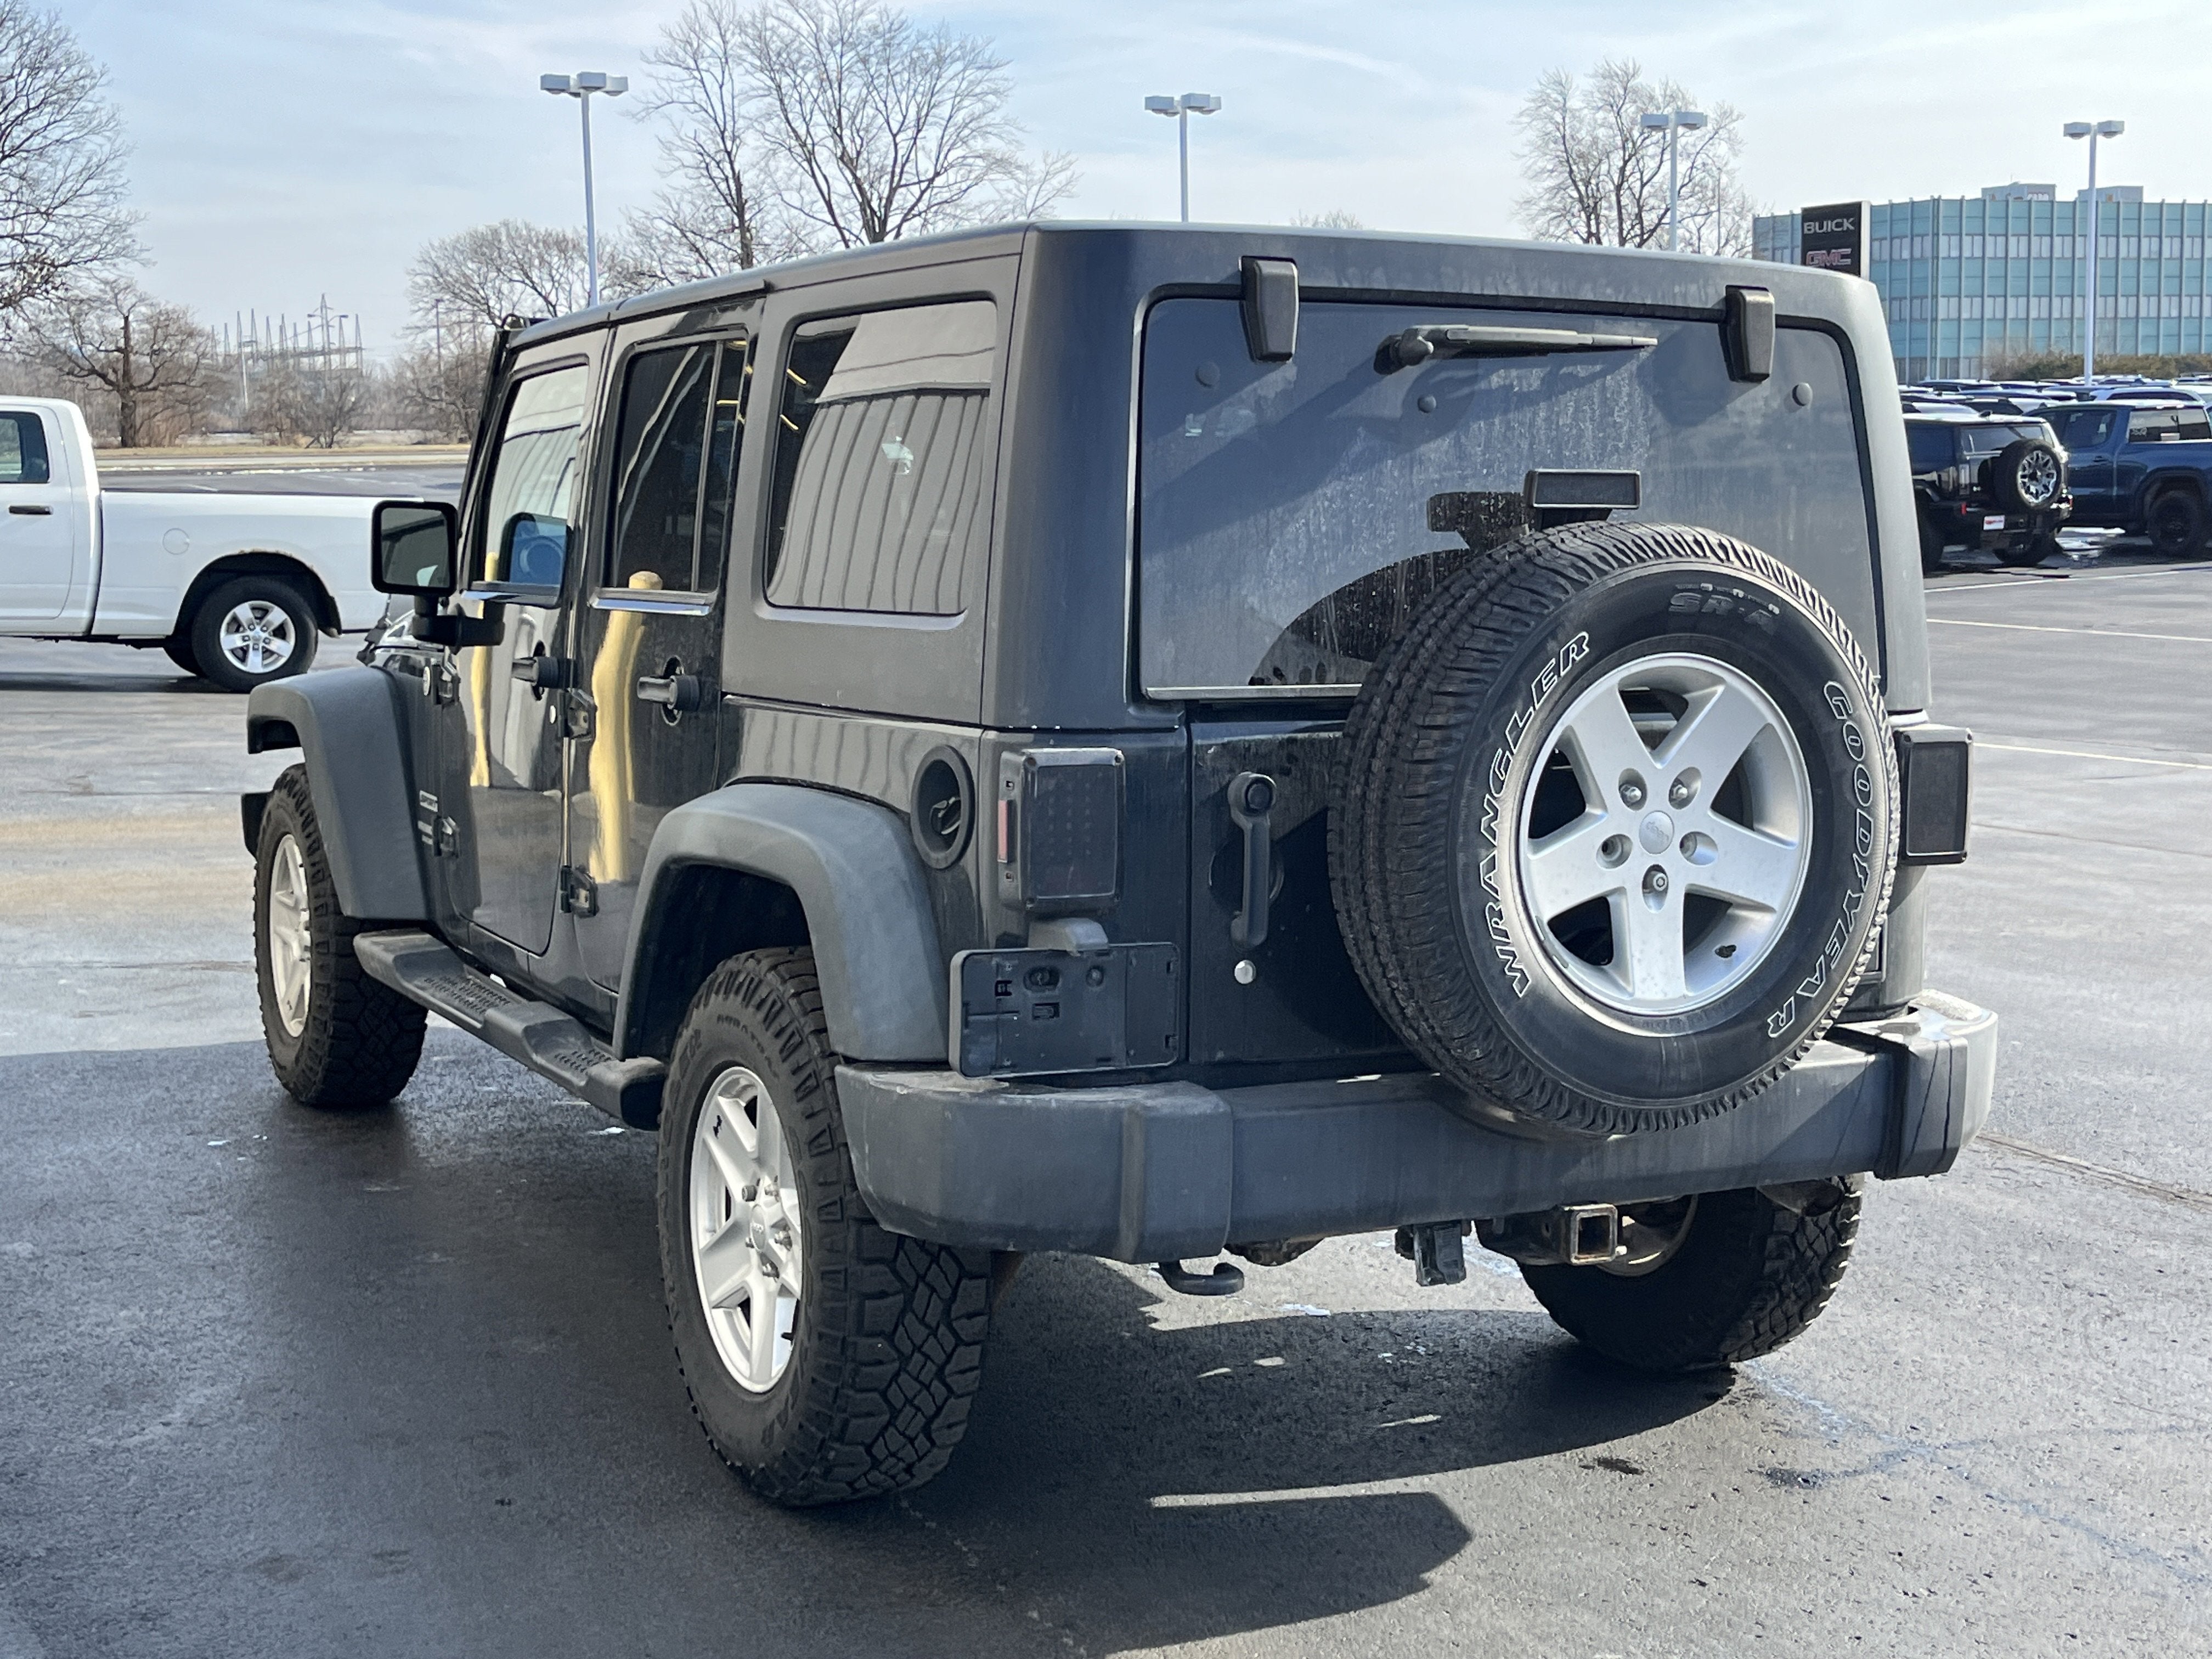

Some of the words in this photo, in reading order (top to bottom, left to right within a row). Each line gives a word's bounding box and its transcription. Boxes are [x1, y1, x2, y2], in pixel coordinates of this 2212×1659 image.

[1804, 218, 1855, 234] BUICK
[1806, 248, 1852, 267] GMC
[1480, 631, 1589, 998] WRANGLER
[1768, 681, 1874, 1039] GOODYEAR
